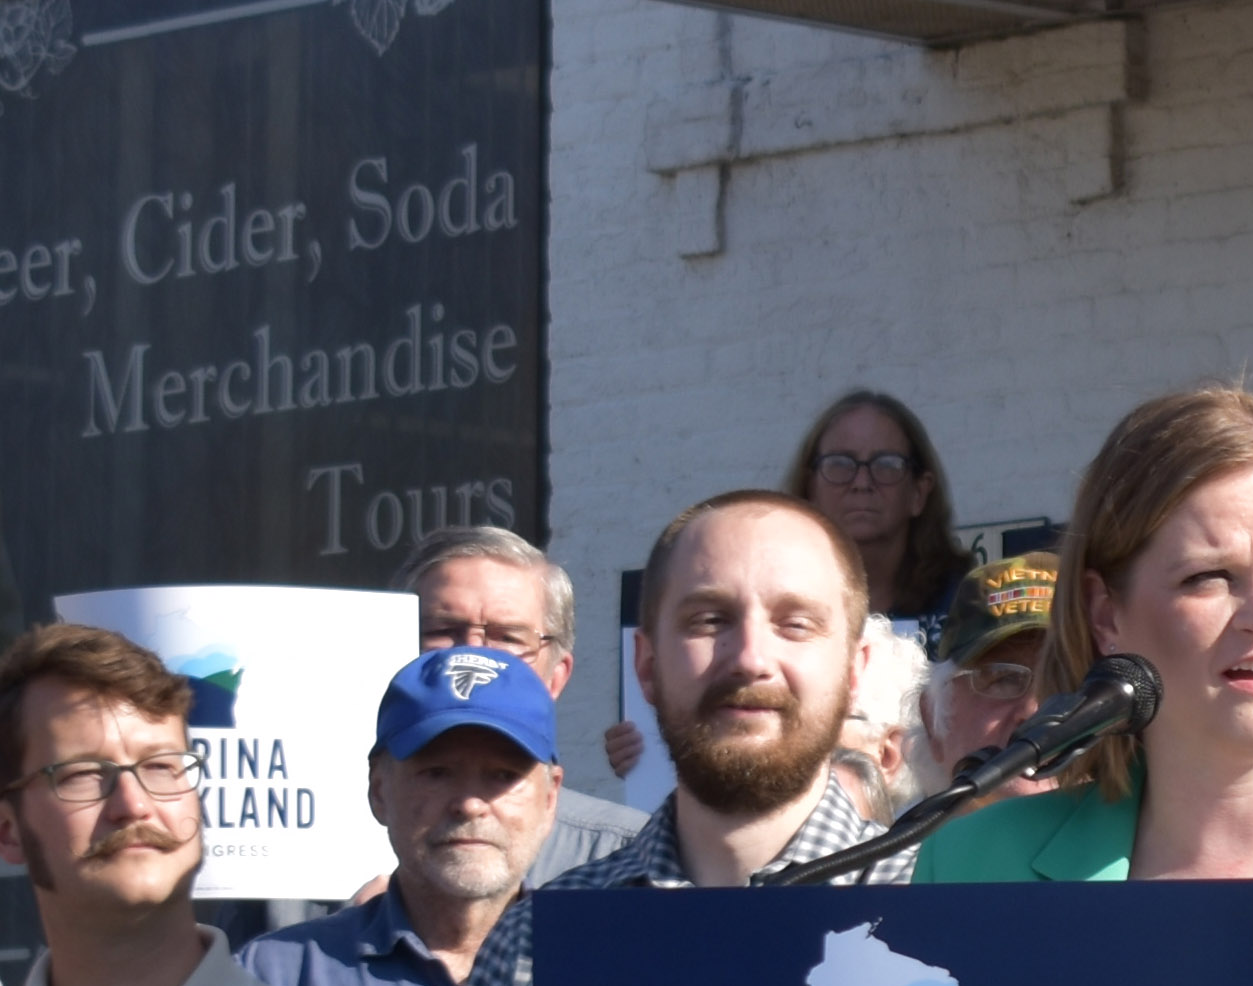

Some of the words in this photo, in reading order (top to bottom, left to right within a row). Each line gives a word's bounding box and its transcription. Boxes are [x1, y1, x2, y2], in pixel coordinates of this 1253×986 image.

[0, 237, 97, 317] eer,
[121, 180, 322, 285] Cider,
[347, 143, 519, 251] Soda
[81, 302, 519, 439] Merchandise
[305, 463, 516, 556] Tours
[985, 568, 1058, 588] VIETN
[991, 599, 1051, 617] VETE
[191, 737, 289, 780] RINA
[199, 786, 316, 829] KLAND
[204, 844, 270, 857] GRESS
